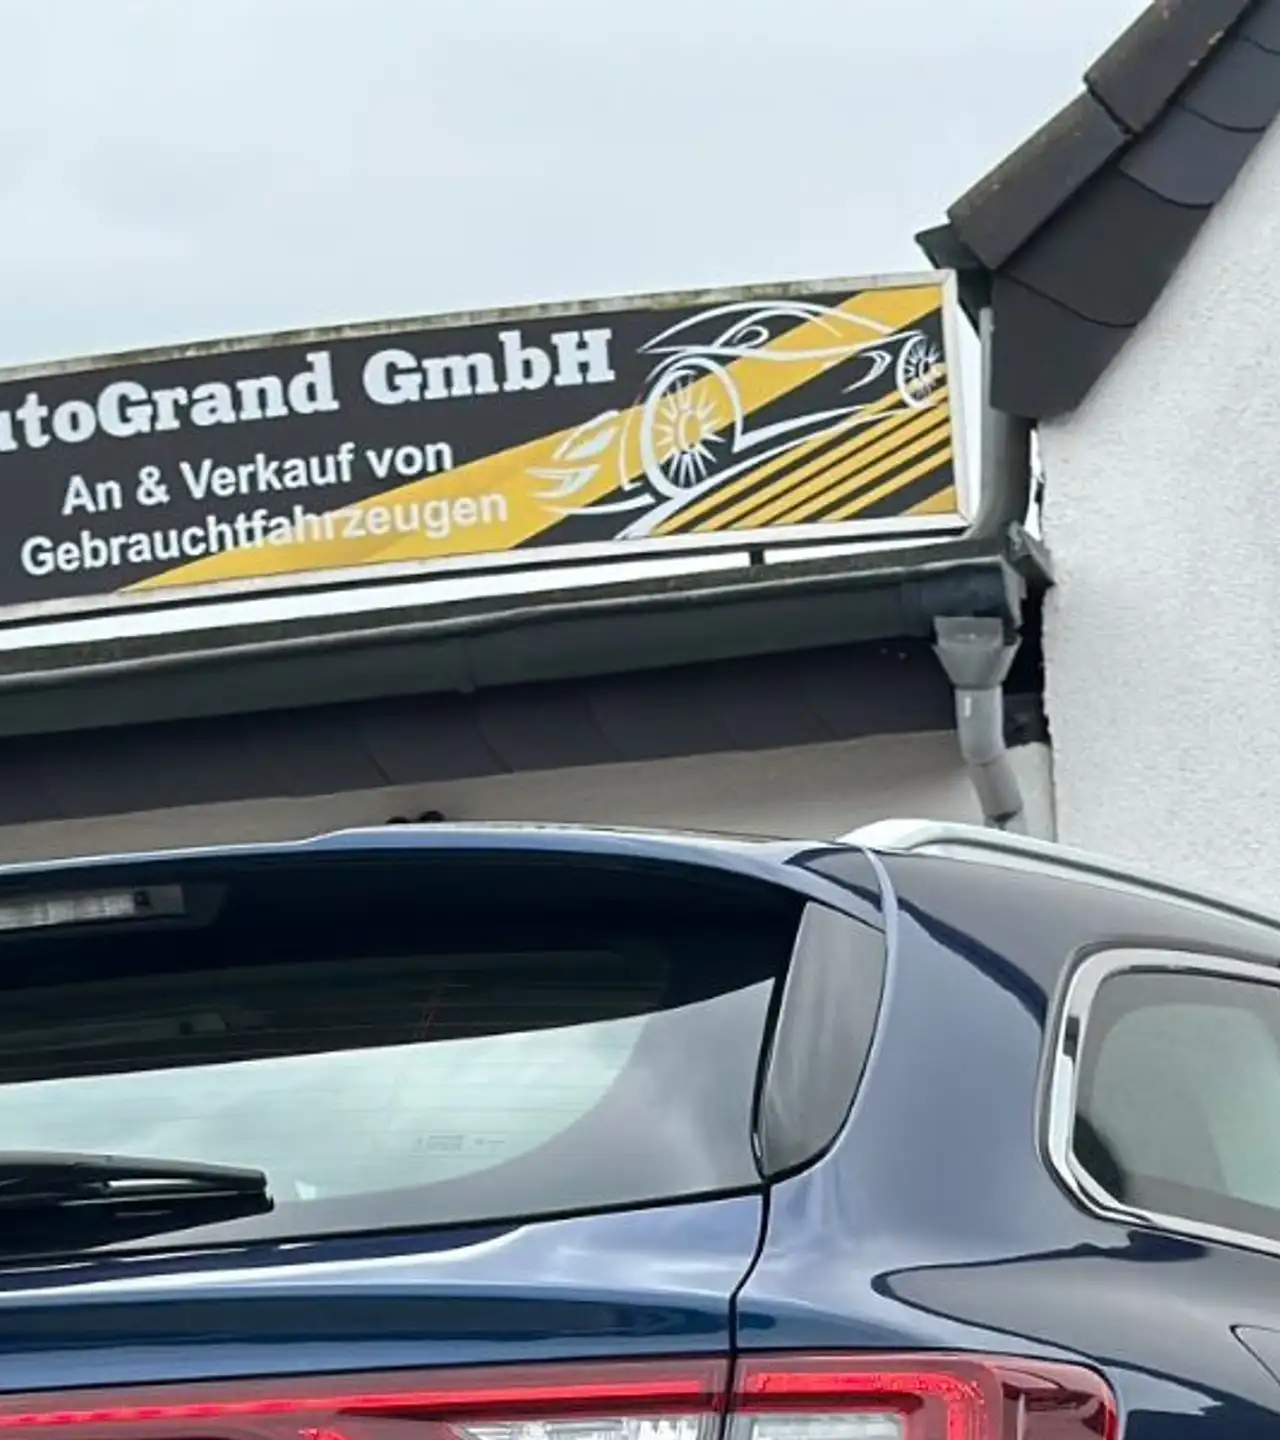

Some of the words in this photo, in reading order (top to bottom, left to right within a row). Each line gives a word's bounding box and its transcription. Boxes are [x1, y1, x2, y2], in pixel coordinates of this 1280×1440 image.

[362, 328, 616, 406] GmbH
[61, 475, 122, 516] An
[136, 466, 170, 507] &
[179, 443, 356, 500] Verkauf
[366, 440, 453, 478] von
[21, 490, 508, 577] Gebrauchtfahrzeugen
